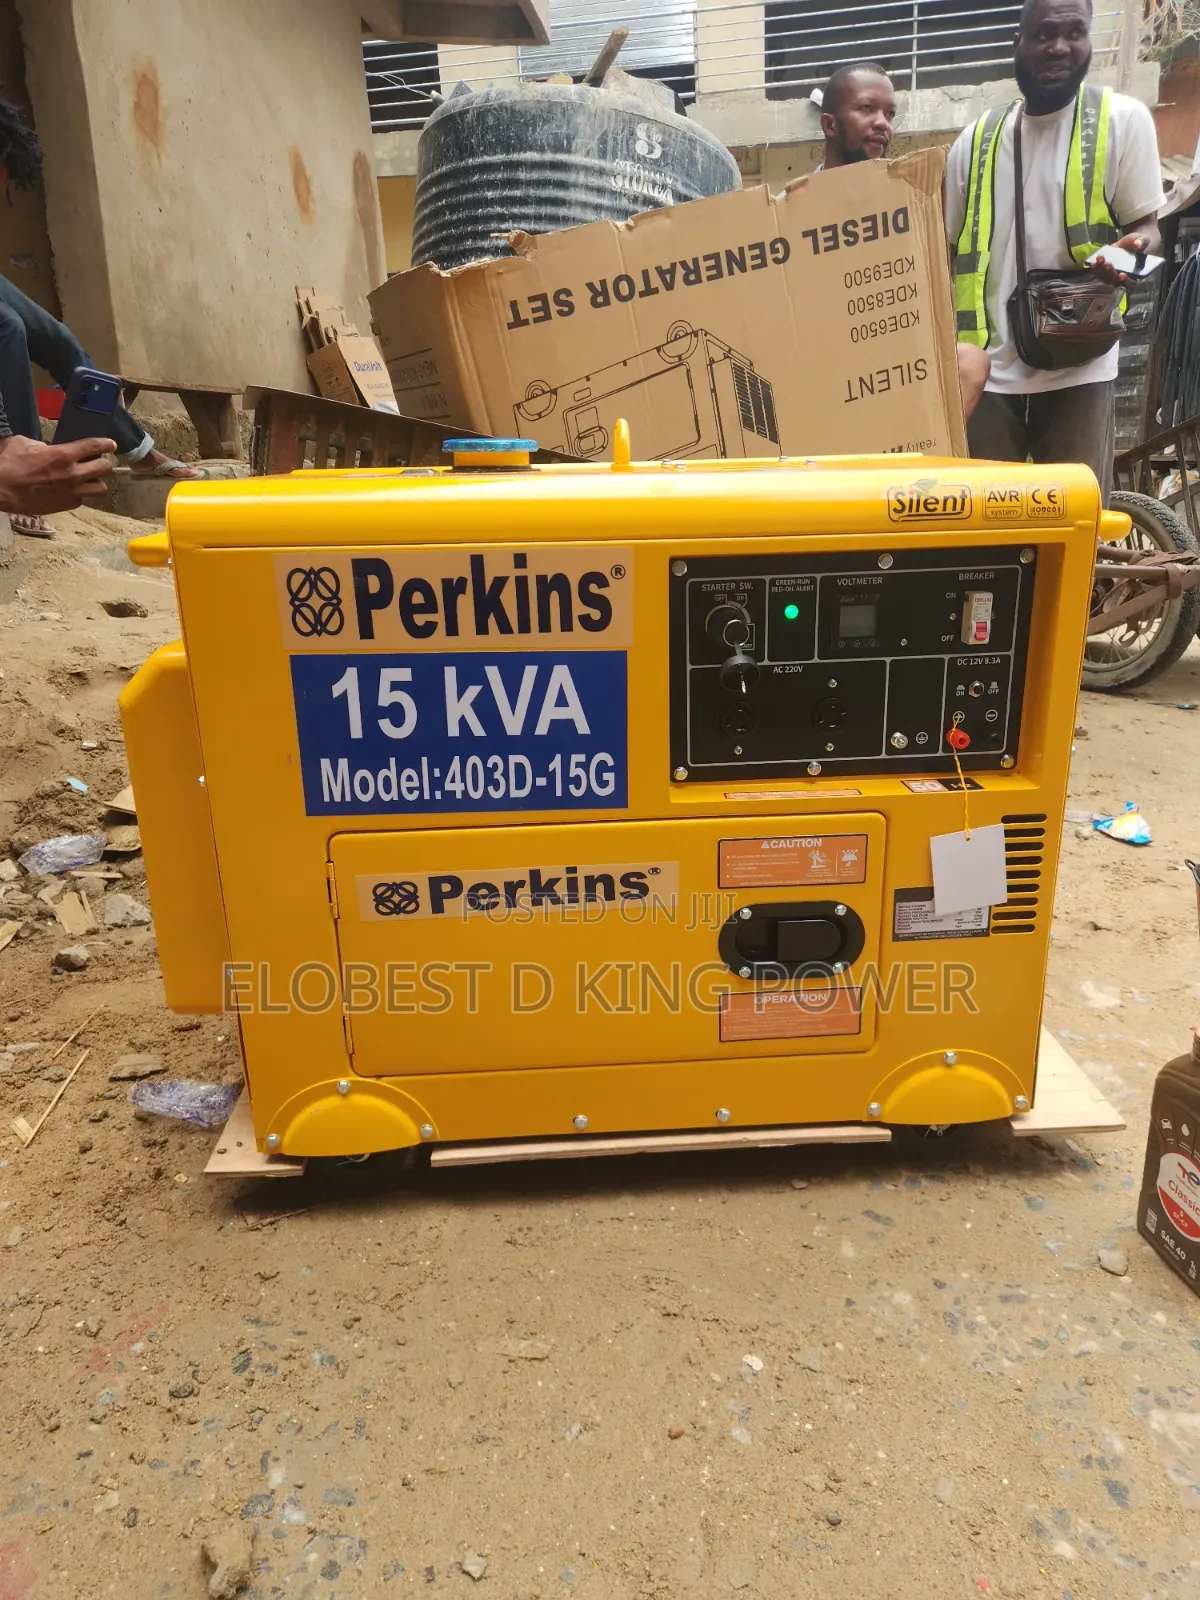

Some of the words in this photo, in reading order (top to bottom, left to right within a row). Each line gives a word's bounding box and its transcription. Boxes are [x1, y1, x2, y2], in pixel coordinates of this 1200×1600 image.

[802, 206, 910, 255] DIESEL
[585, 236, 791, 309] GENERATOR
[844, 255, 915, 289] KDE9500
[507, 286, 575, 330] SET
[847, 282, 918, 316] KDE8500
[850, 309, 920, 343] KDE6500
[844, 358, 928, 403] SILENT
[892, 489, 968, 514] Silent
[987, 490, 1020, 503] AVR
[1031, 489, 1057, 504] CE
[990, 507, 1017, 517] system
[701, 583, 736, 592] STARTER
[739, 582, 754, 590] SW.
[837, 577, 883, 586] VOLTMETER
[958, 572, 995, 581] BREAKER
[773, 666, 784, 674] AC
[785, 665, 804, 673] 220V
[957, 658, 968, 666] DC
[984, 657, 1001, 665] 8.3A
[331, 667, 418, 739] 15
[444, 664, 591, 738] kVA
[319, 752, 616, 803] Model:403D-15G
[910, 781, 943, 792] 50
[770, 838, 822, 848] CAUTION
[755, 993, 828, 1004] OPERATION
[1168, 1180, 1200, 1217] Classic
[1160, 1229, 1175, 1249] SAE
[1176, 1247, 1186, 1260] 40
